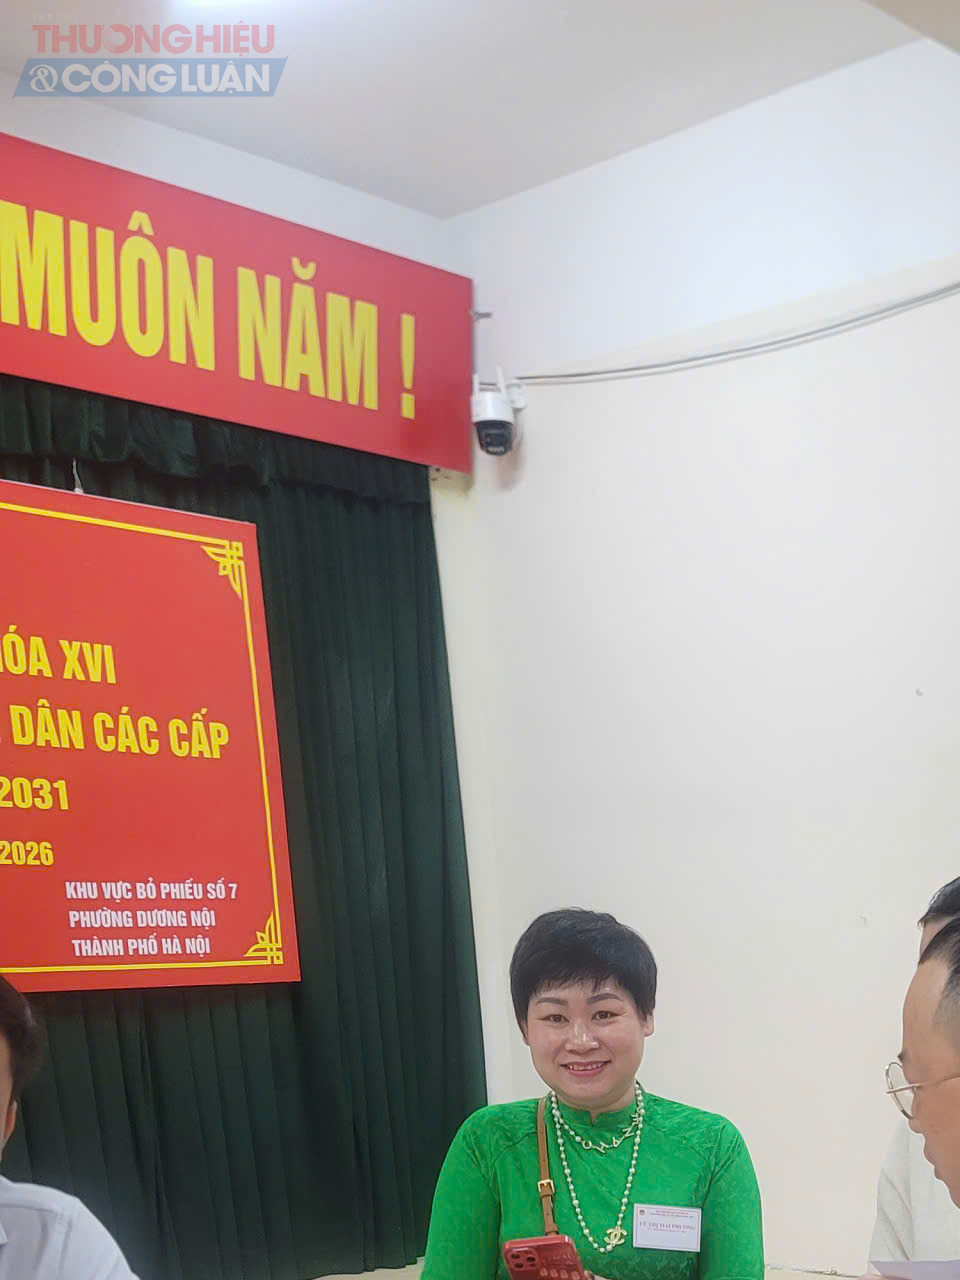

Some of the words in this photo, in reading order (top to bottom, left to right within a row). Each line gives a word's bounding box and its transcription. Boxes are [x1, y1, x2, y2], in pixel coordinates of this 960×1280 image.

[0, 201, 216, 371] MUÔN
[237, 257, 379, 411] NĂM
[0, 625, 53, 678] ÓA
[59, 639, 117, 684] XVI
[9, 698, 85, 750] DÂN
[93, 706, 160, 755] CÁC
[168, 707, 230, 759] CẤP
[0, 776, 69, 810] 2031
[0, 840, 54, 866] 2026
[65, 881, 98, 899] KHU
[101, 880, 133, 902] VỰC
[136, 877, 156, 899] BỎ
[160, 877, 202, 899] PHIẾU
[207, 877, 226, 899] SỐ
[228, 883, 238, 899] 7
[68, 907, 133, 928] PHƯỜNG
[137, 908, 188, 928] DƯƠNG
[190, 907, 216, 930] NỘI
[72, 936, 124, 956] THÀNH
[127, 933, 158, 956] PHỐ
[162, 935, 182, 955] HÀ
[185, 935, 211, 957] NỘI
